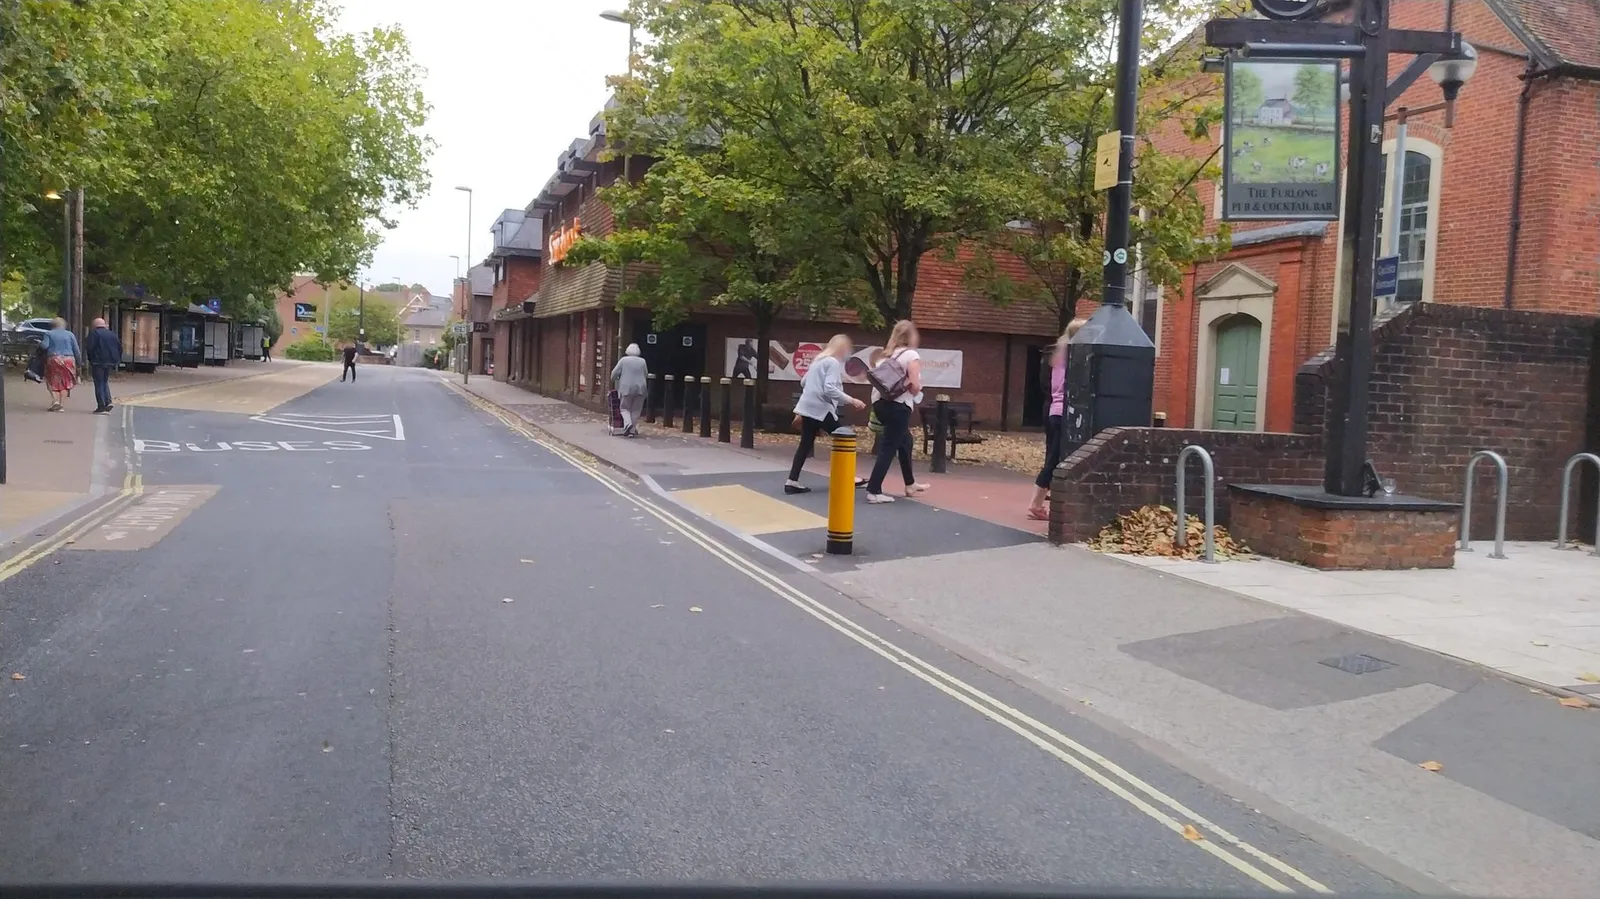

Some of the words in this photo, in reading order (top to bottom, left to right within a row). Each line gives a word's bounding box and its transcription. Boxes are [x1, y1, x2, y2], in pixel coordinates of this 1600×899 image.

[1252, 203, 1259, 212] &
[1262, 203, 1311, 212] COCKTAIL
[1313, 202, 1333, 211] BAR
[133, 439, 372, 452] BUSES
